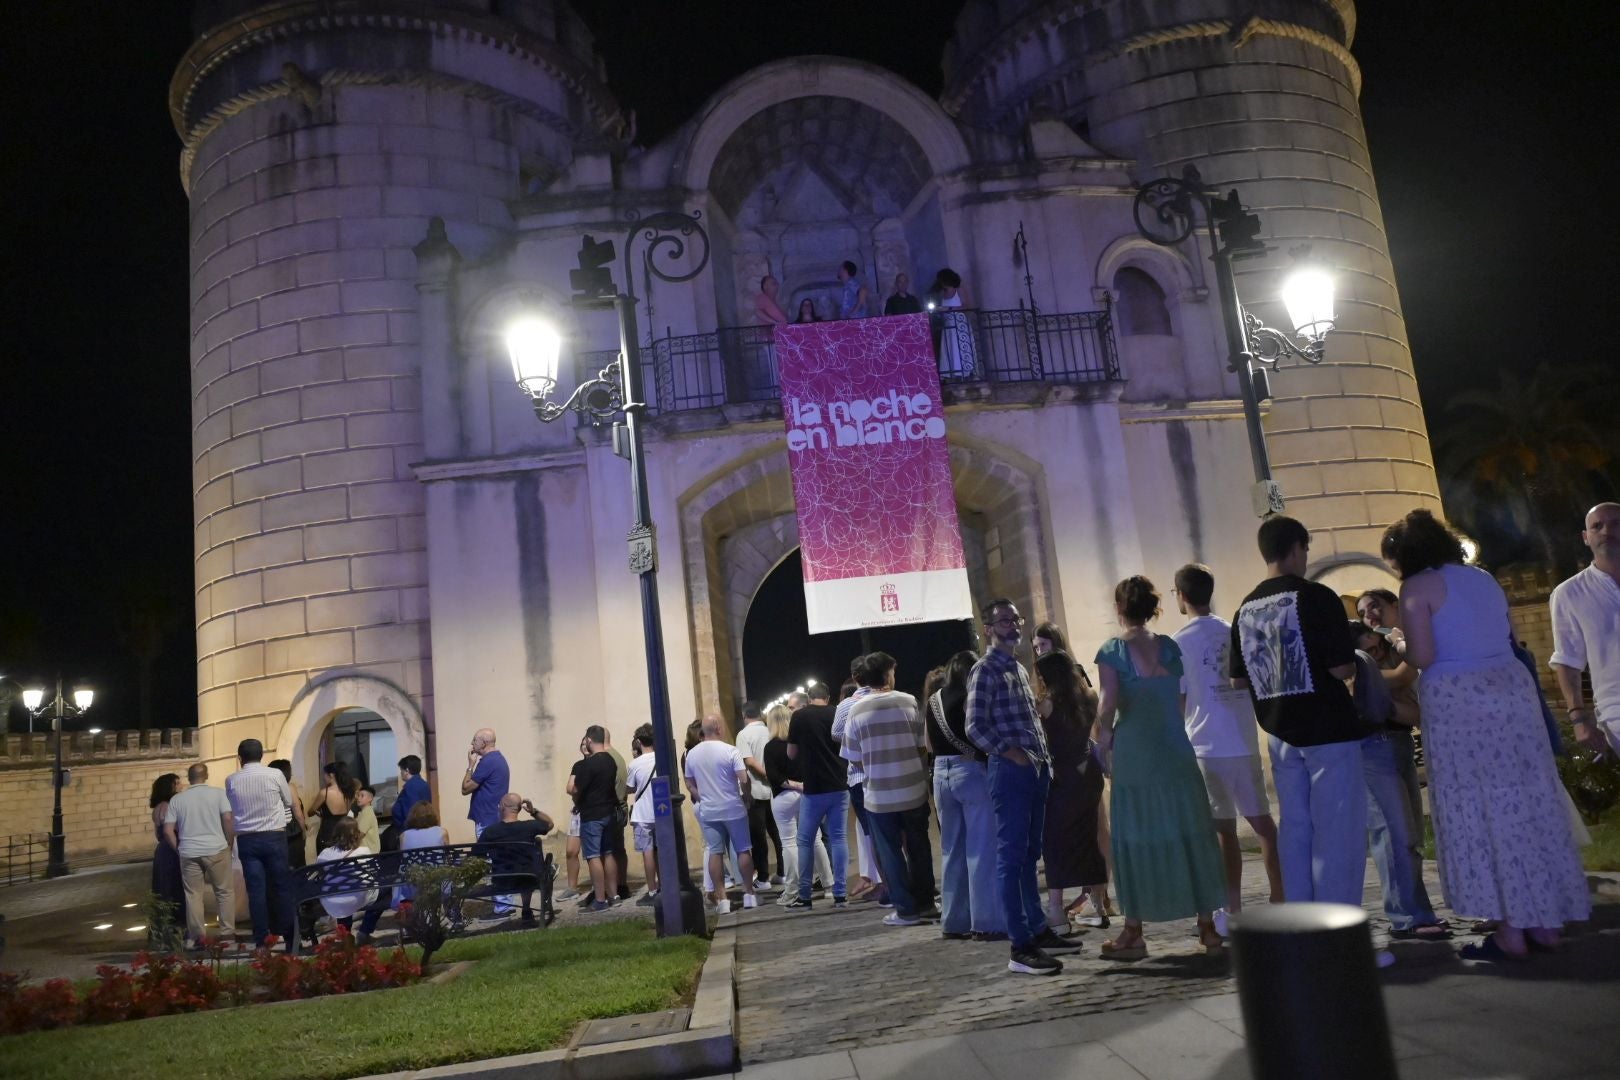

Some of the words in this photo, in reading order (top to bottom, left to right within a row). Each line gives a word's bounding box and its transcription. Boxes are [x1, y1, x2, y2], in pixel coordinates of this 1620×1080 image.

[792, 397, 822, 426] la
[828, 389, 932, 422] noche
[787, 427, 829, 451] en
[834, 416, 946, 447] blanco
